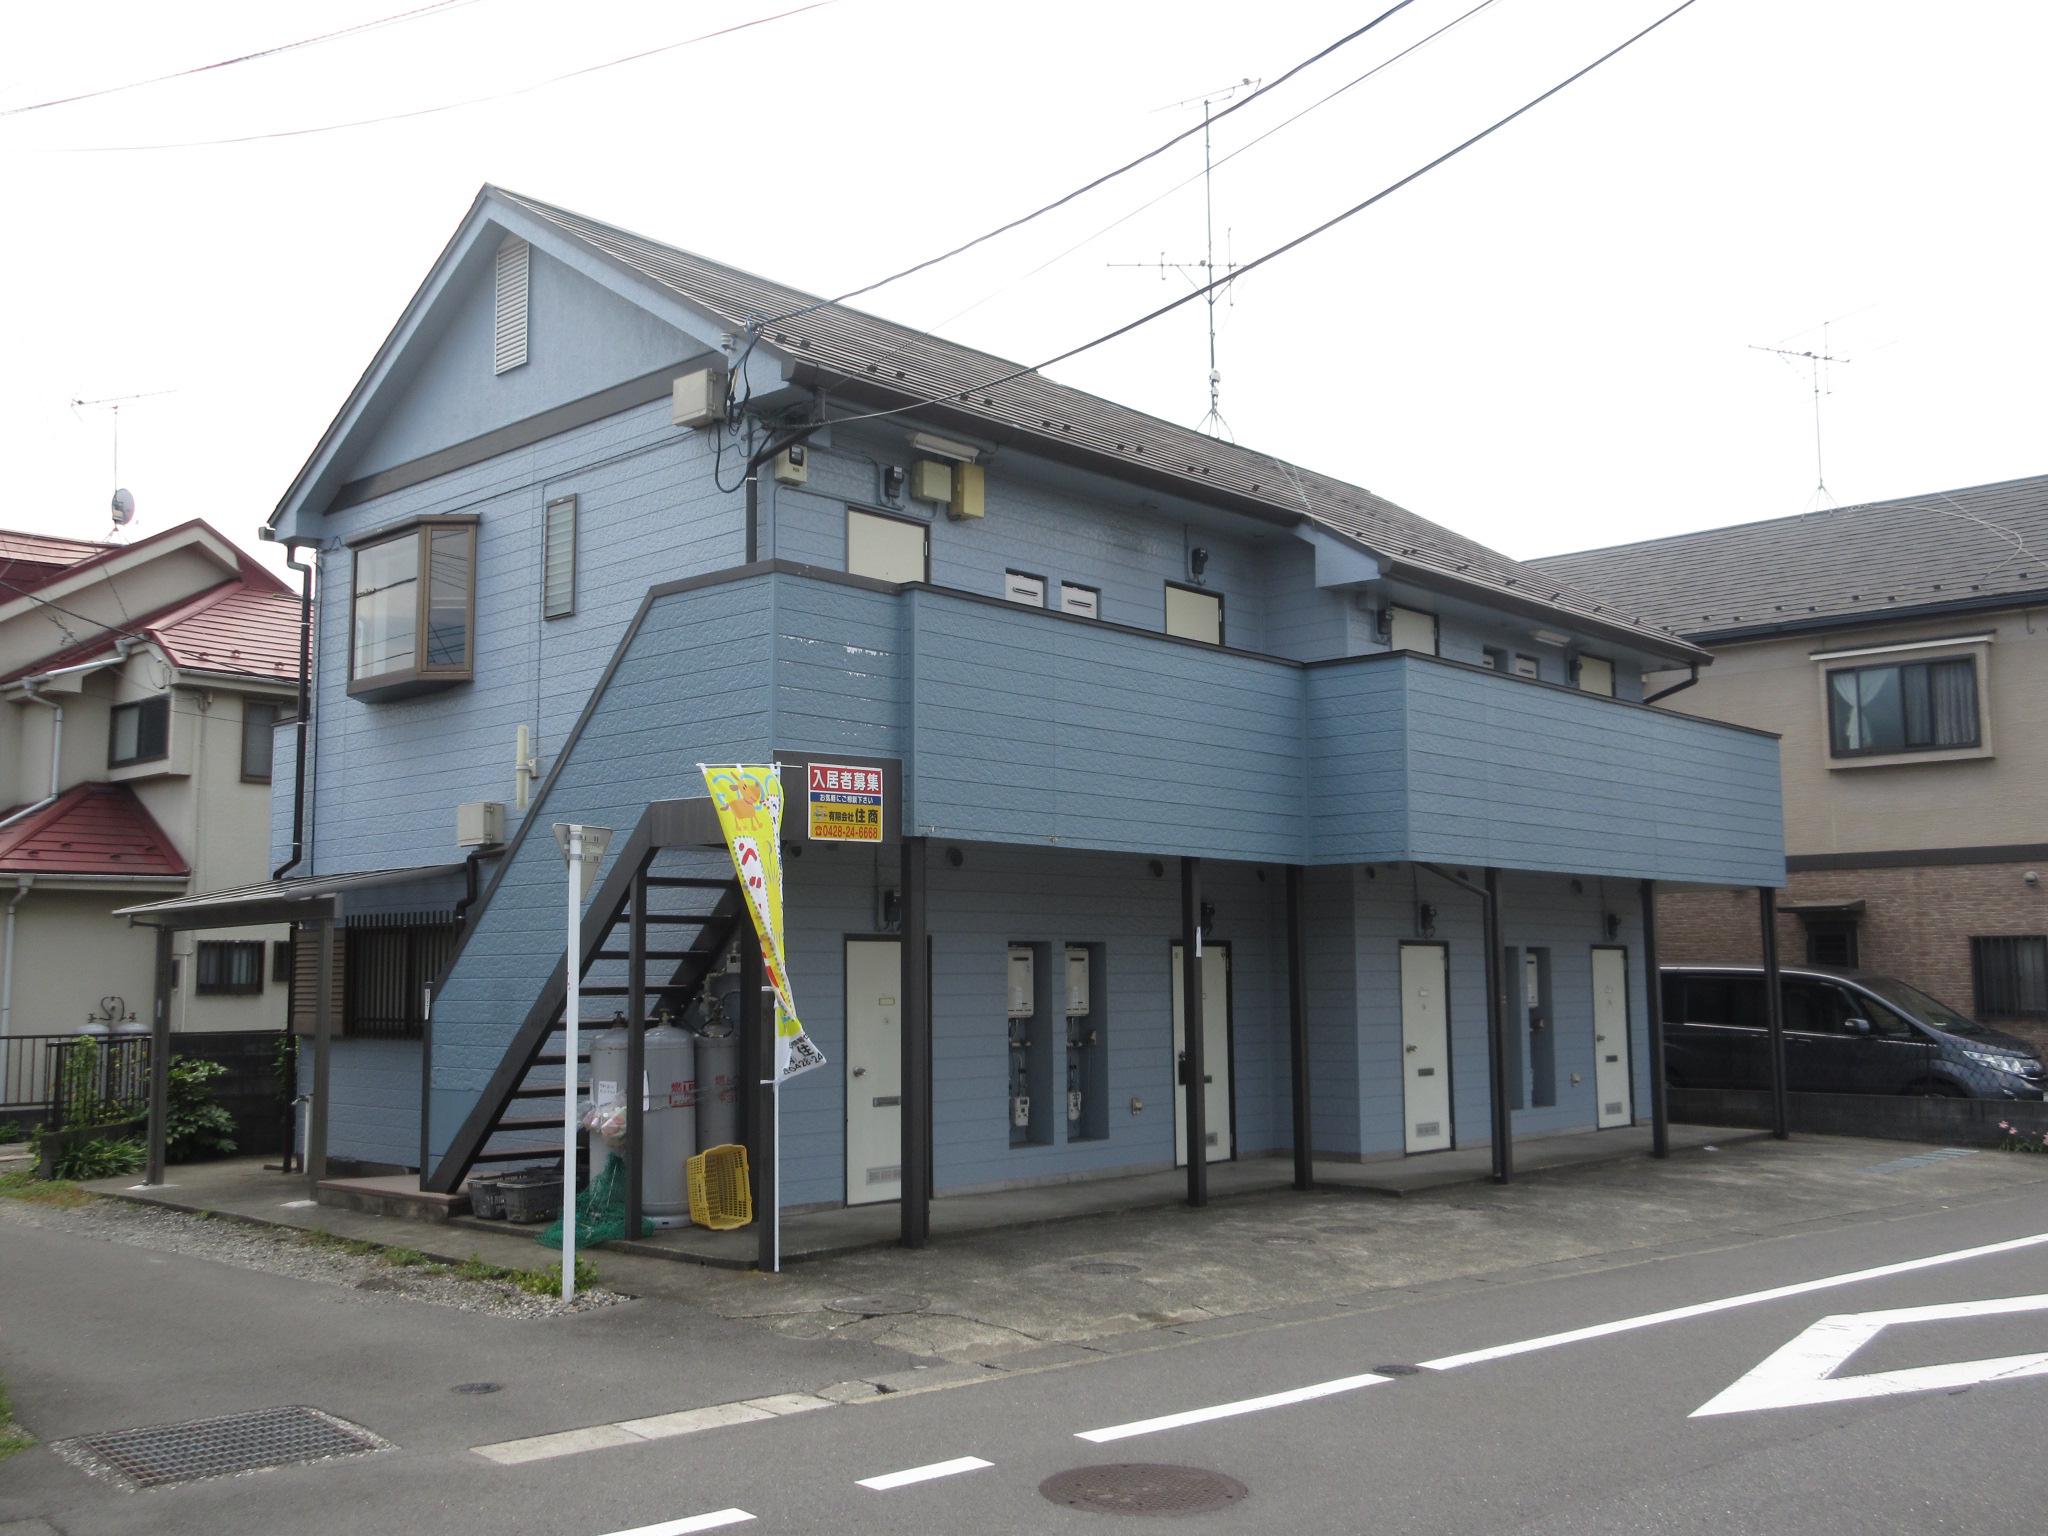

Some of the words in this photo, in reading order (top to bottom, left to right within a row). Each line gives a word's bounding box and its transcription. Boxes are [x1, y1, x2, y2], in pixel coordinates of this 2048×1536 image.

[812, 769, 879, 791] 入居者募集
